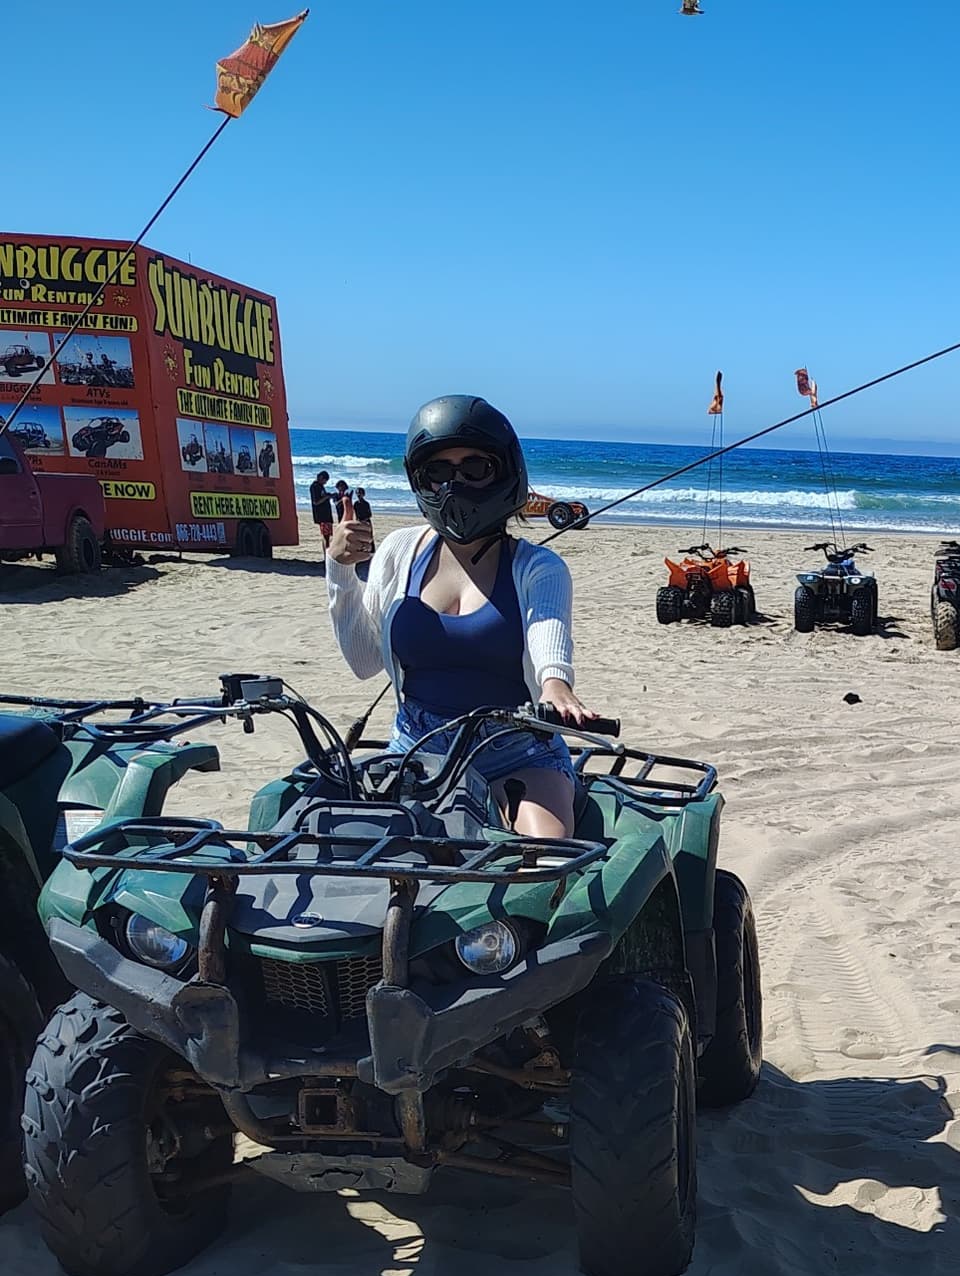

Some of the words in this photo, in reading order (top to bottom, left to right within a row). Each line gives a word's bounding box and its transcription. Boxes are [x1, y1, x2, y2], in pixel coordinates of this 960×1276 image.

[148, 259, 274, 363] SUNBUGGIE
[102, 316, 133, 330] FUN!
[86, 388, 111, 398] ATVs
[179, 390, 194, 413] THE
[195, 393, 228, 419] ULTIMATE
[229, 399, 253, 424] FAMILY
[114, 484, 150, 498] NOW
[193, 495, 215, 515] RENT
[215, 497, 235, 515] HERE
[243, 499, 259, 516] RIDE
[260, 500, 277, 516] NOW
